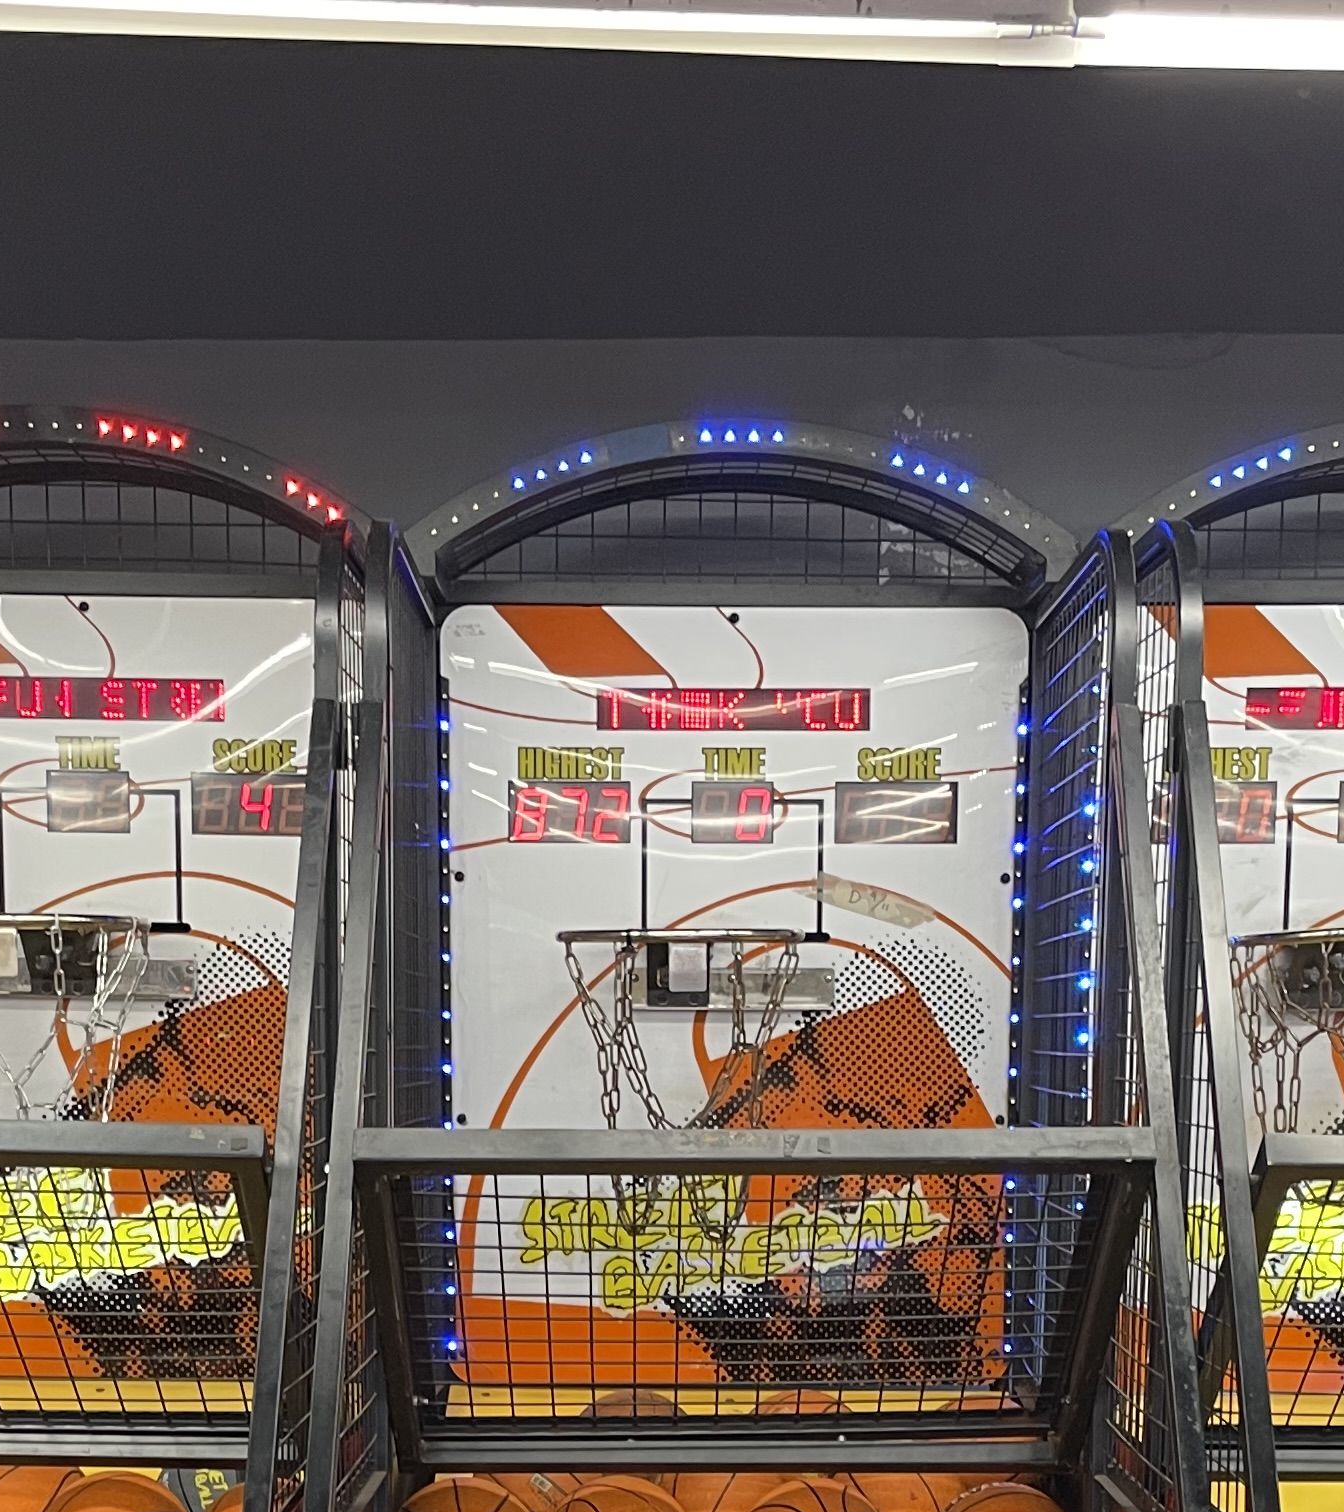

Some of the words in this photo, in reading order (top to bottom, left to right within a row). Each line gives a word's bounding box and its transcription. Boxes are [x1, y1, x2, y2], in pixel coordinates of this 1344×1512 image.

[55, 736, 121, 771] TIME
[213, 738, 298, 773] SCORE
[517, 747, 625, 781] HIGHEST
[703, 747, 767, 781] TIME
[857, 747, 943, 782] SCORE
[1211, 747, 1273, 780] HEST
[240, 782, 273, 831] 4
[513, 787, 630, 841] 872
[736, 788, 770, 841] 0
[519, 1174, 746, 1265] STREET
[601, 1191, 943, 1311] BASKETBALL
